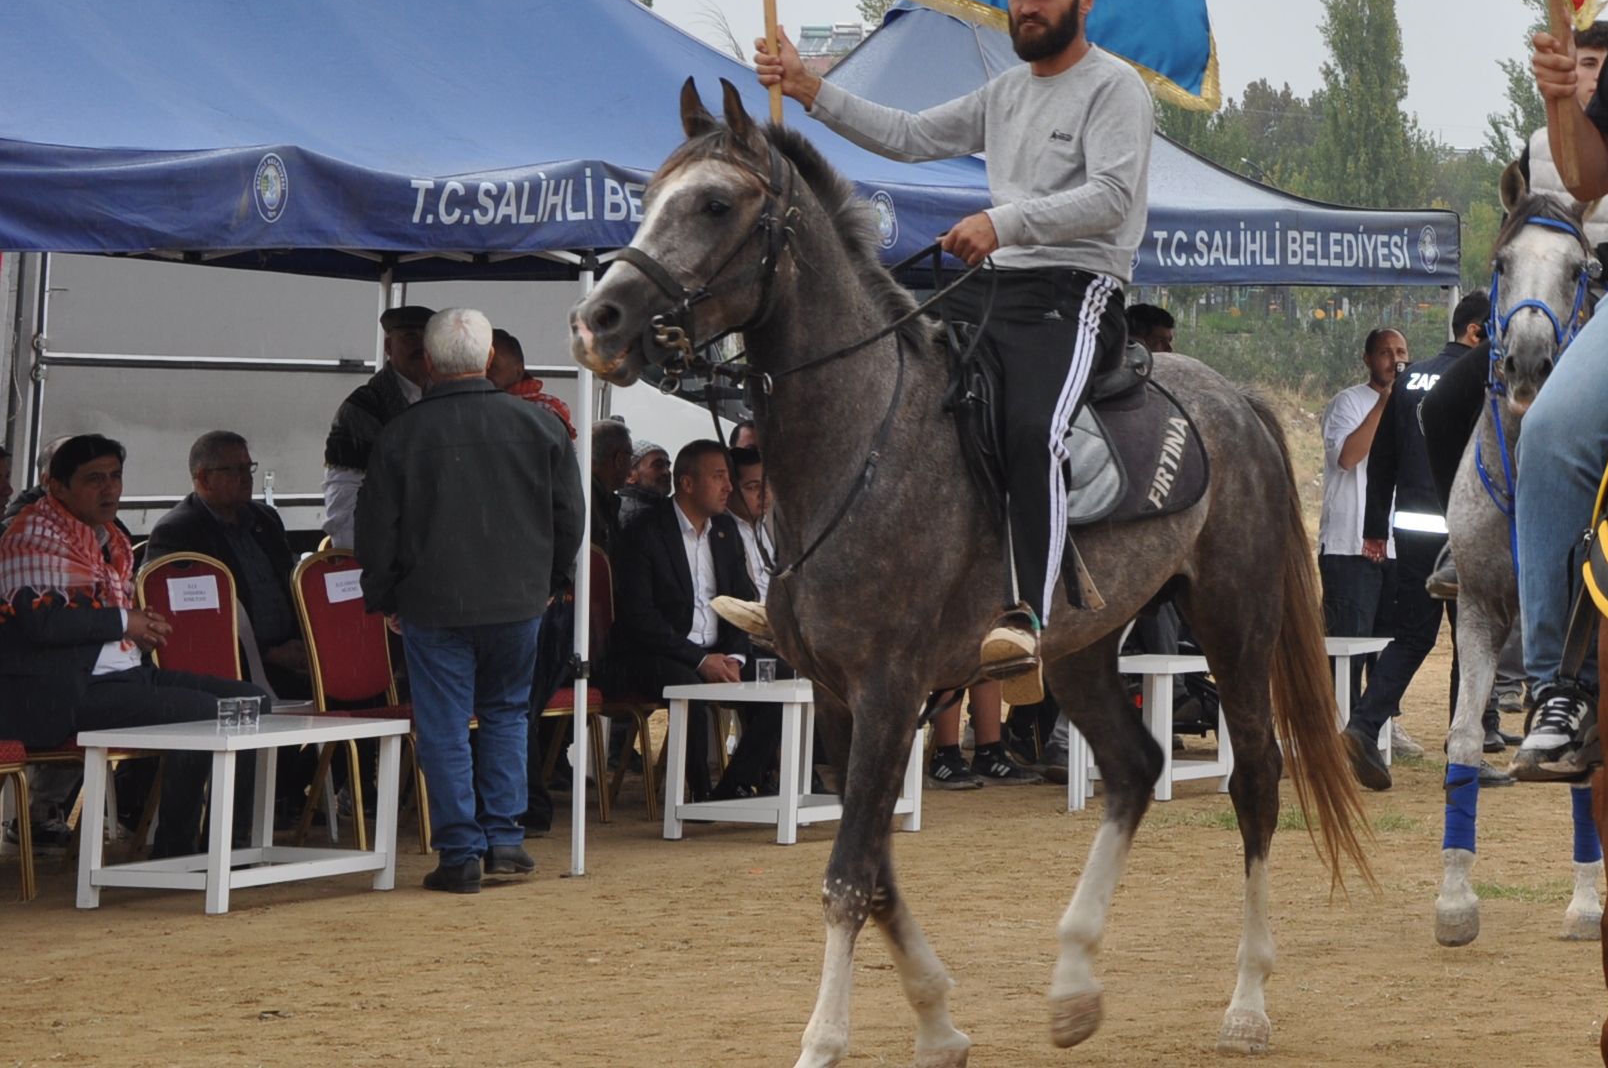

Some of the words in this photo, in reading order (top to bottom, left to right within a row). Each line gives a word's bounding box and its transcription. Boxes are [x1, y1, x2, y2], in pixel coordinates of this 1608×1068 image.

[410, 167, 594, 225] T.C.SALİHLİ
[604, 177, 646, 222] BE
[1153, 221, 1281, 267] T.C.SALİHLİ
[1287, 225, 1411, 269] BELEDİYESİ
[1148, 417, 1189, 510] FIRTINA
